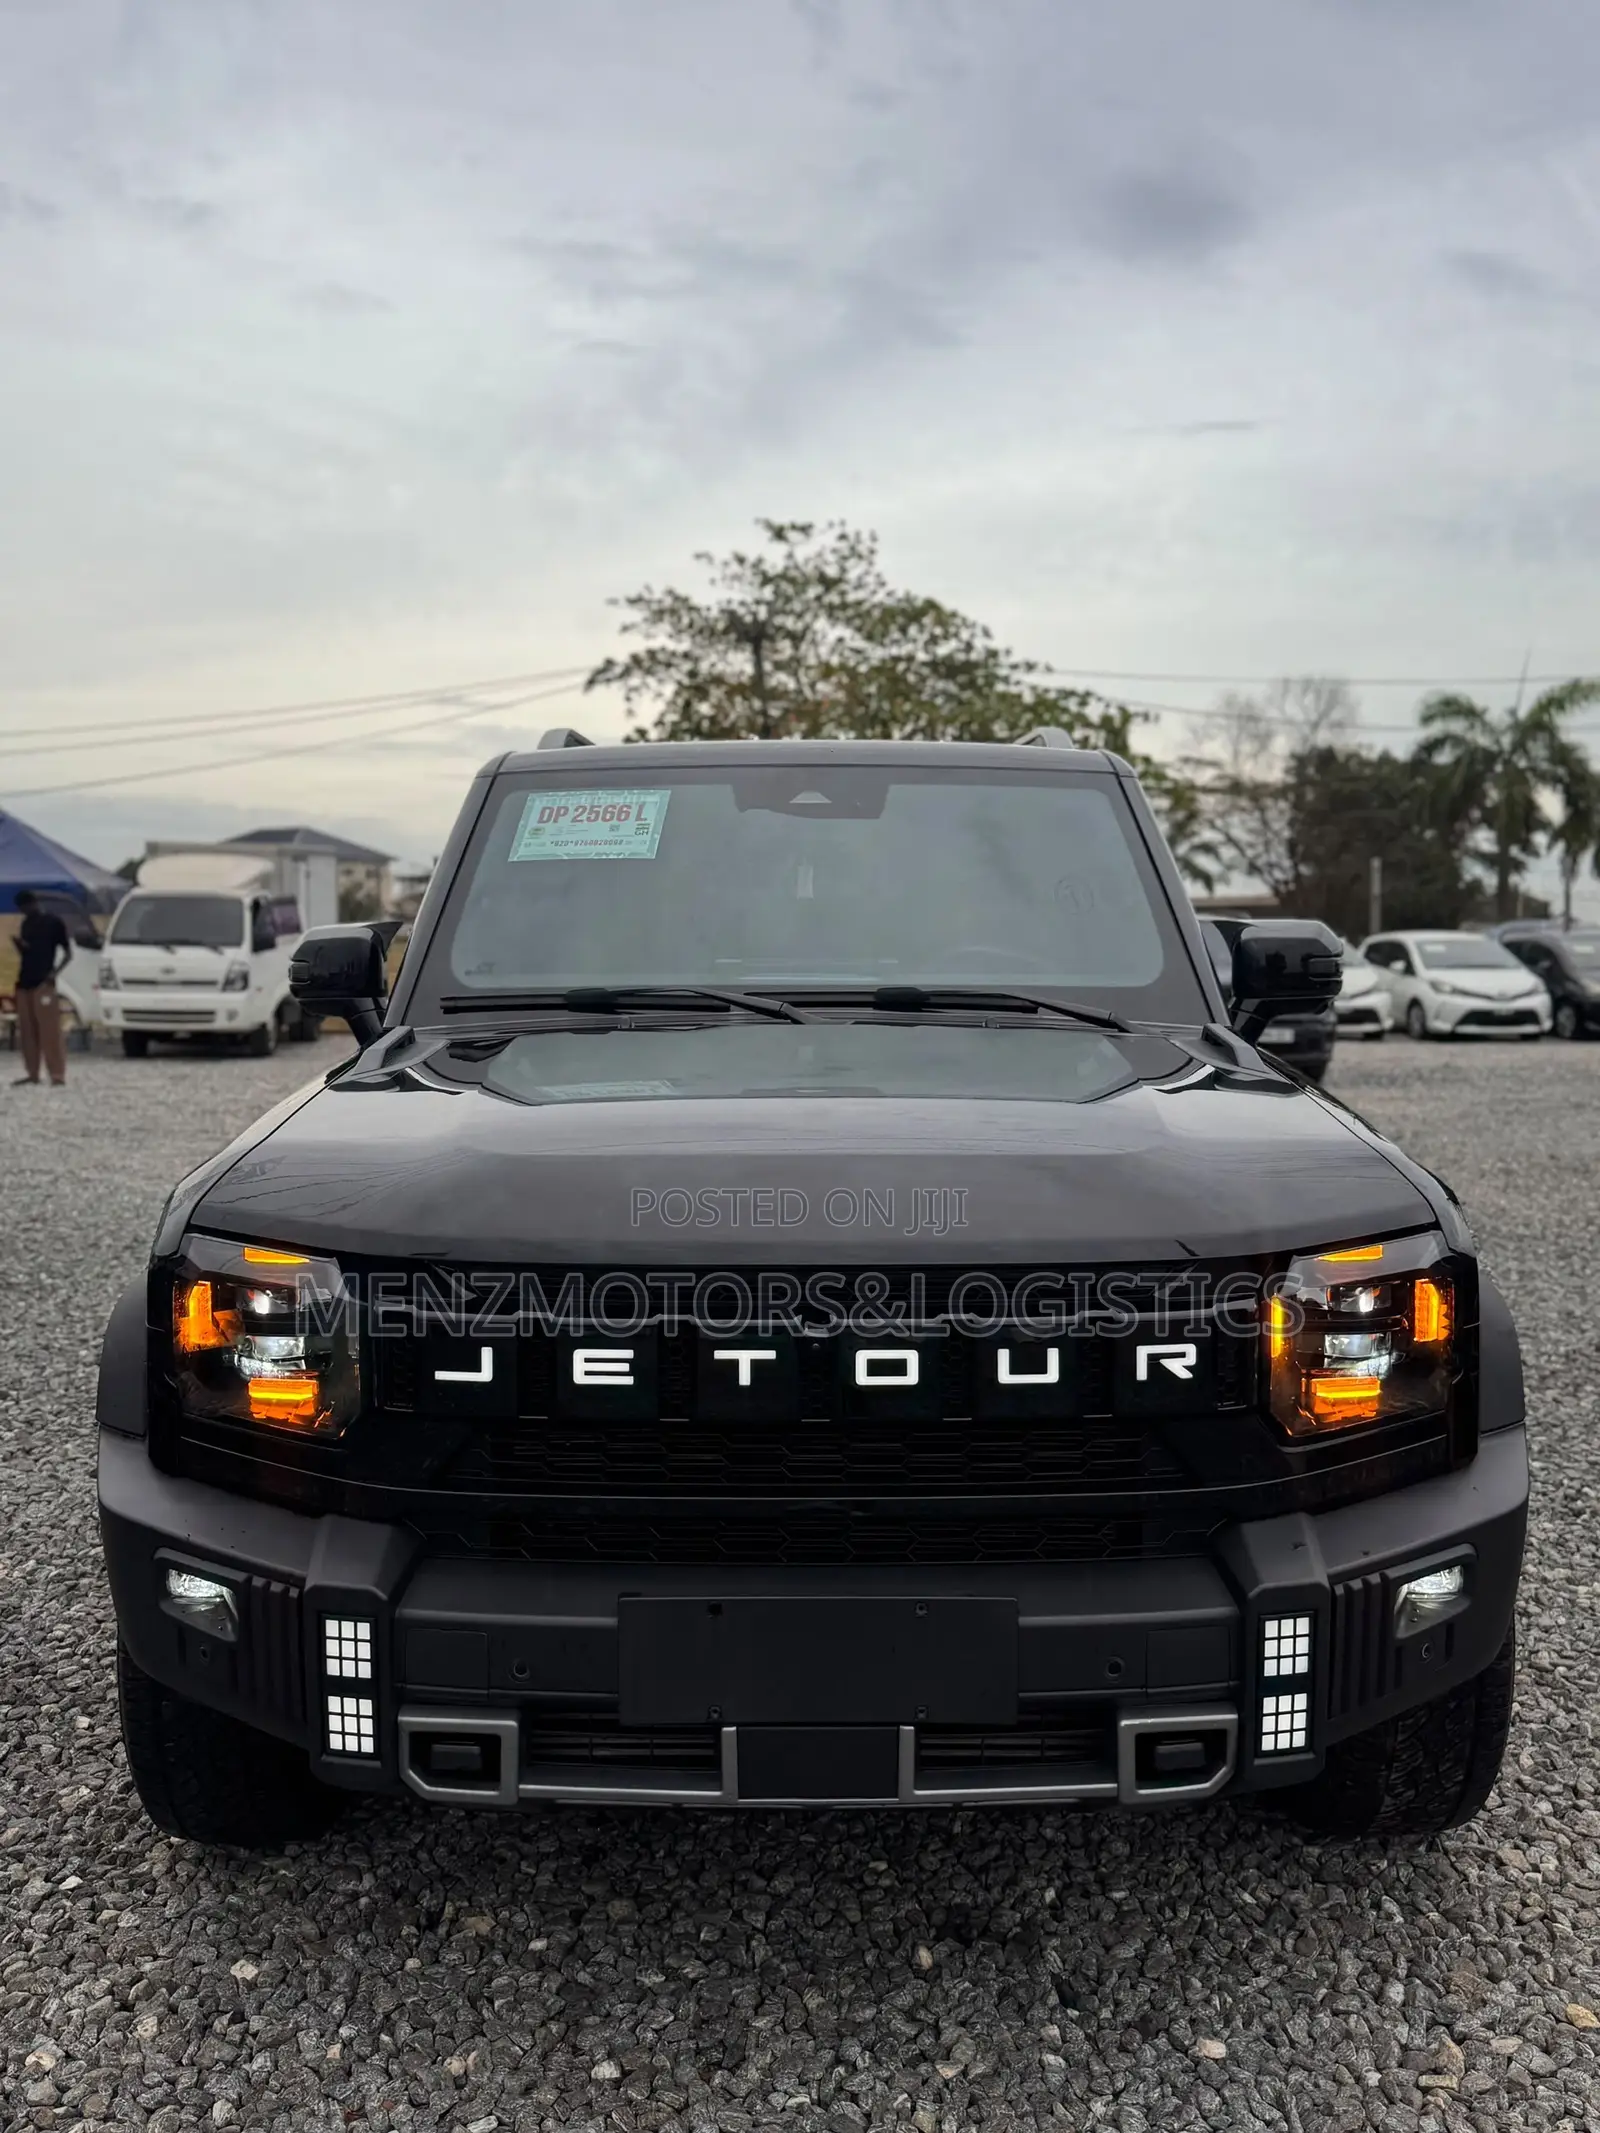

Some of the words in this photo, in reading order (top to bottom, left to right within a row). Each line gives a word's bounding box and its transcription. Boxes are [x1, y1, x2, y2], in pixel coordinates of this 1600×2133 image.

[537, 806, 569, 824] DP
[570, 804, 633, 824] 2566
[635, 803, 648, 822] L
[434, 1343, 1197, 1386] JETOUR
